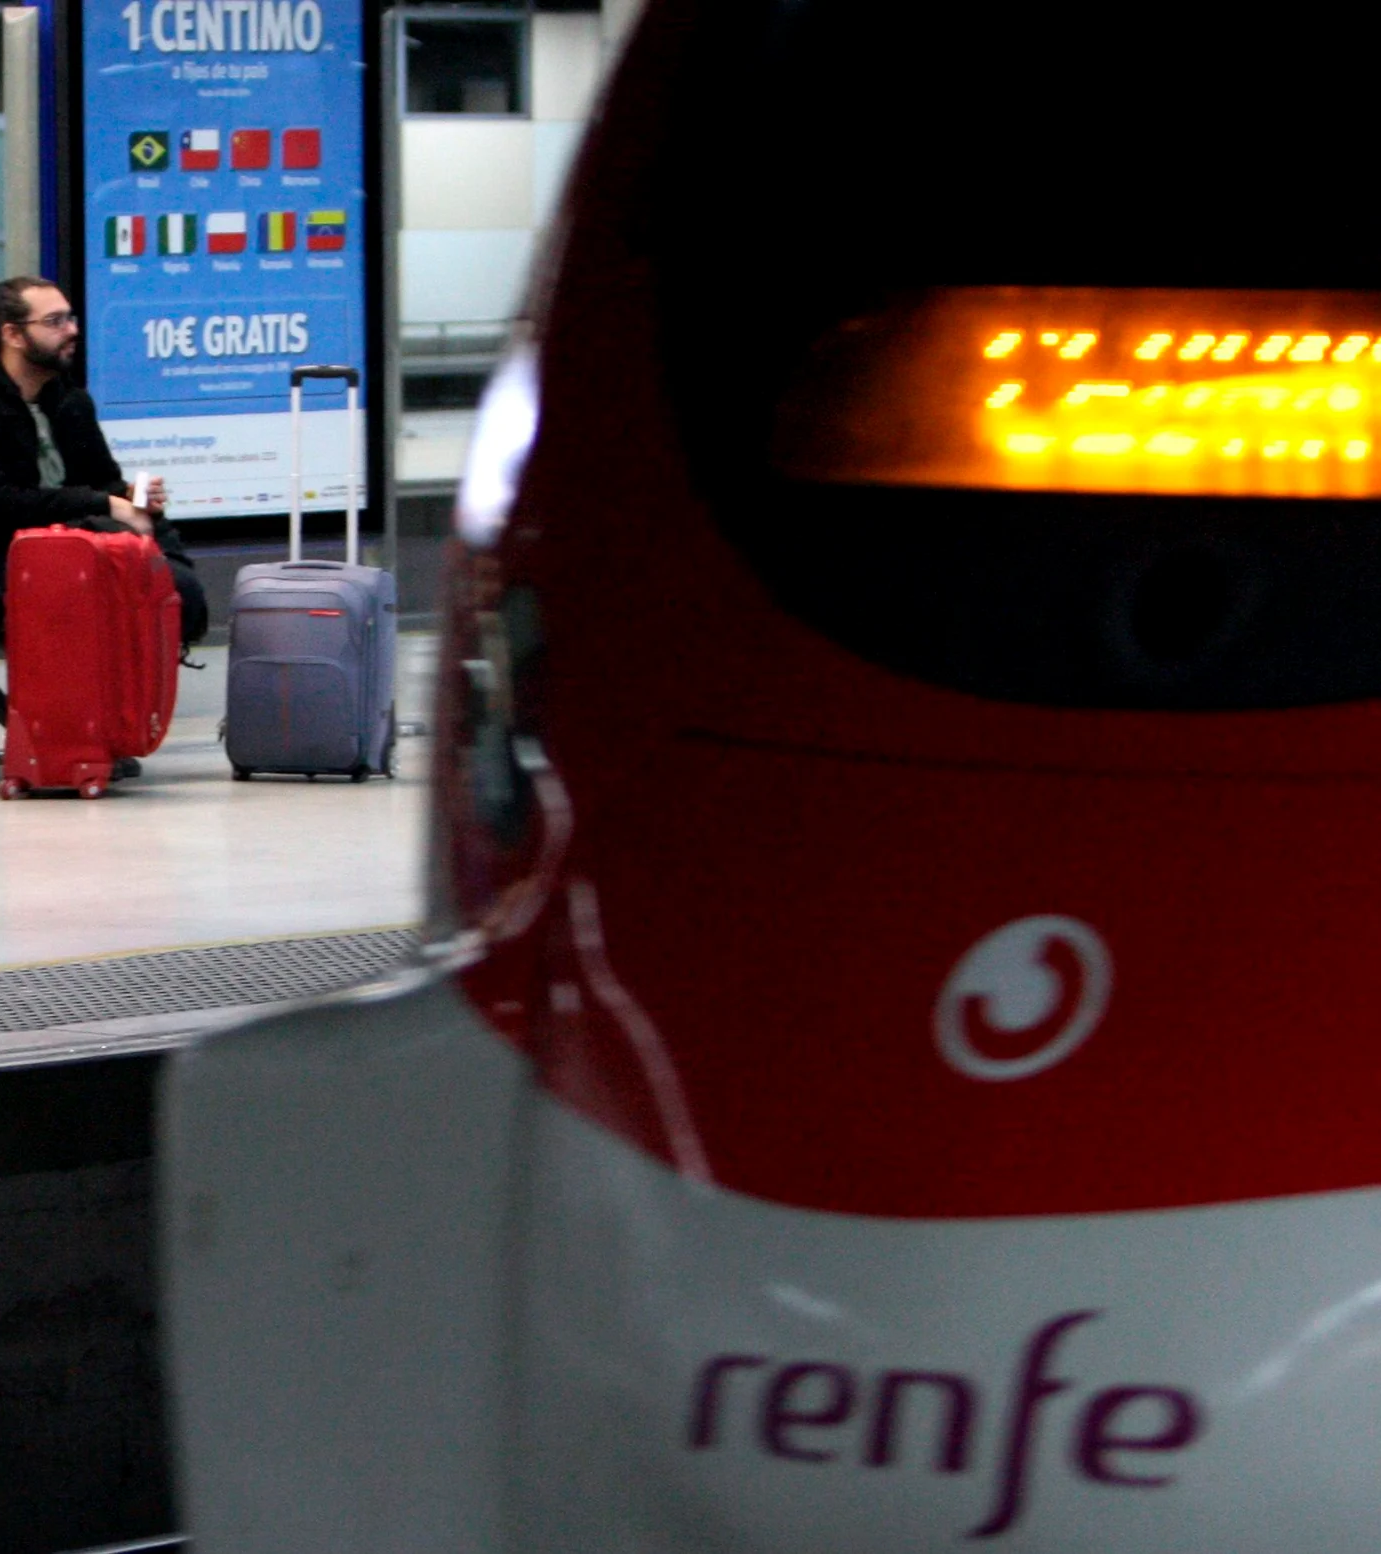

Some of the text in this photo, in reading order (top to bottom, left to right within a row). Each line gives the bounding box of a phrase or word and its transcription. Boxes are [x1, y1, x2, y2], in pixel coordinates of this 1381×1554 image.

[122, 0, 141, 51] 1
[211, 61, 227, 79] de
[143, 312, 309, 358] 10€ GRATIS
[685, 1308, 1206, 1539] renfe
